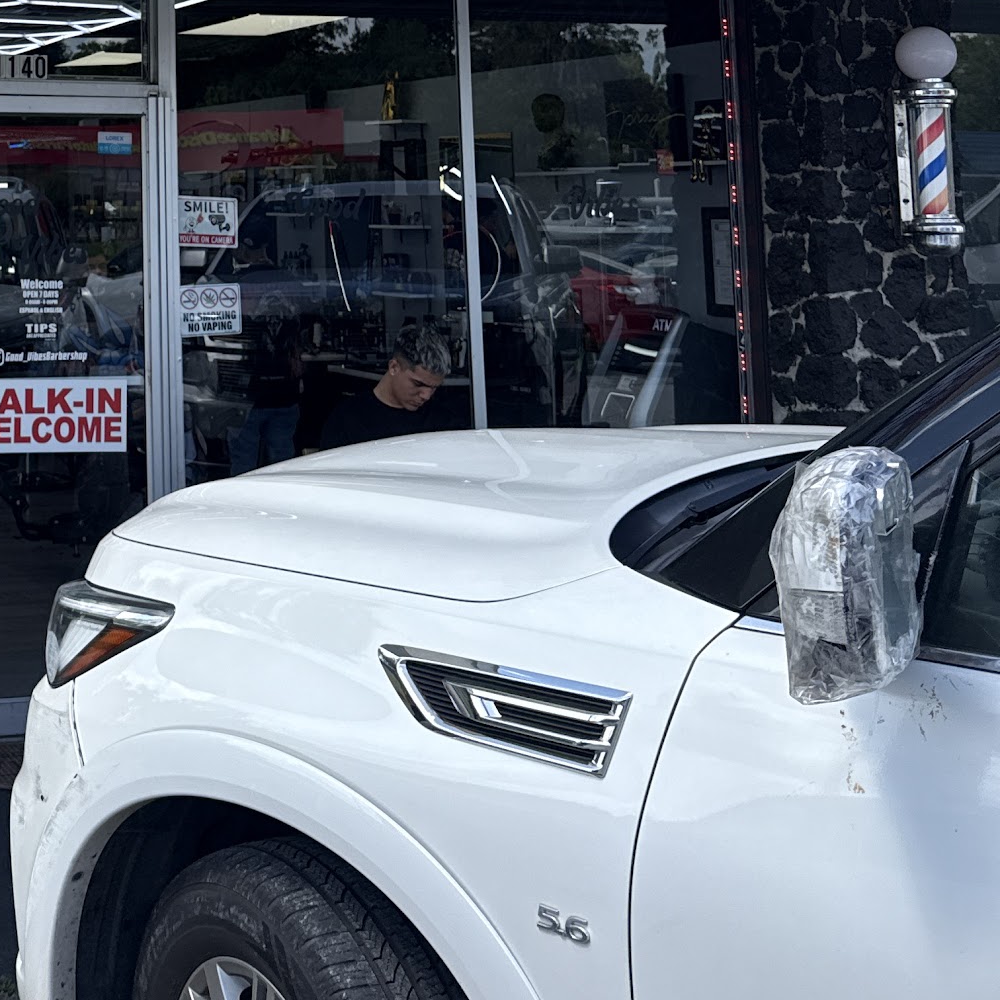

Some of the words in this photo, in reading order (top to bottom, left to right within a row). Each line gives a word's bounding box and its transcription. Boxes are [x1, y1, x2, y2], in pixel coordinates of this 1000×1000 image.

[184, 201, 229, 214] SMILE!
[180, 234, 199, 243] YOU'RE
[201, 236, 210, 244] ON
[211, 236, 233, 244] CAMERA
[20, 279, 63, 289] Welcome
[22, 290, 39, 298] OPEN
[39, 290, 43, 298] 7
[43, 290, 59, 298] DAYS
[183, 312, 195, 322] NO
[197, 310, 237, 321] SMOKING
[25, 323, 58, 333] TIPS
[188, 322, 200, 333] NO
[202, 320, 233, 332] VAPING
[537, 903, 591, 944] 5.6
